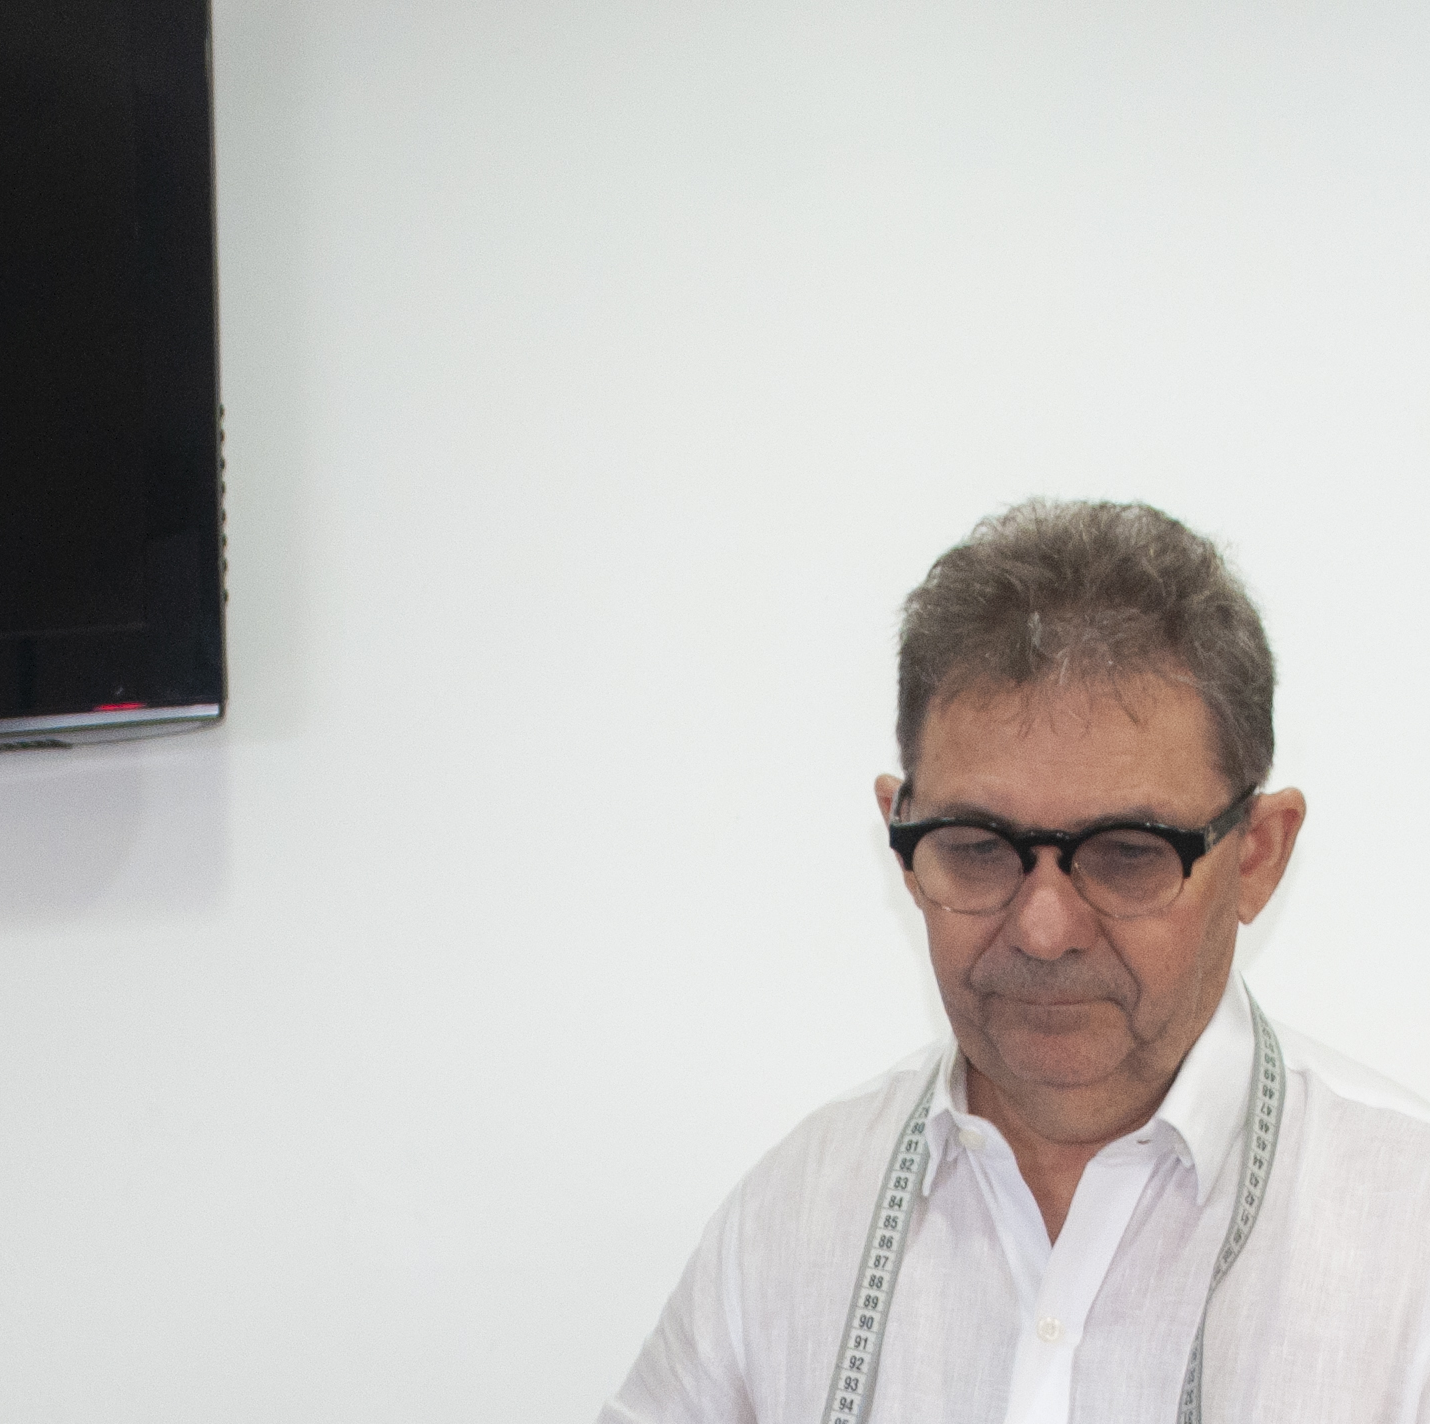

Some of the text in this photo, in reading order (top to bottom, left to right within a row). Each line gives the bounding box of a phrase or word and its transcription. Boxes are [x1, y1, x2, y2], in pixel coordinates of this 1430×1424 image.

[911, 1122, 924, 1134] 80
[906, 1139, 919, 1152] 81
[900, 1158, 914, 1170] 82
[894, 1177, 908, 1189] 83
[889, 1196, 903, 1209] 84
[883, 1216, 897, 1229] 85
[879, 1235, 893, 1249] 86
[874, 1255, 888, 1268] 87
[869, 1275, 883, 1289] 88
[863, 1295, 878, 1309] 89
[859, 1316, 873, 1330] 90
[854, 1336, 868, 1349] 91
[849, 1356, 863, 1370] 92
[844, 1377, 858, 1391] 93
[839, 1398, 853, 1412] 94
